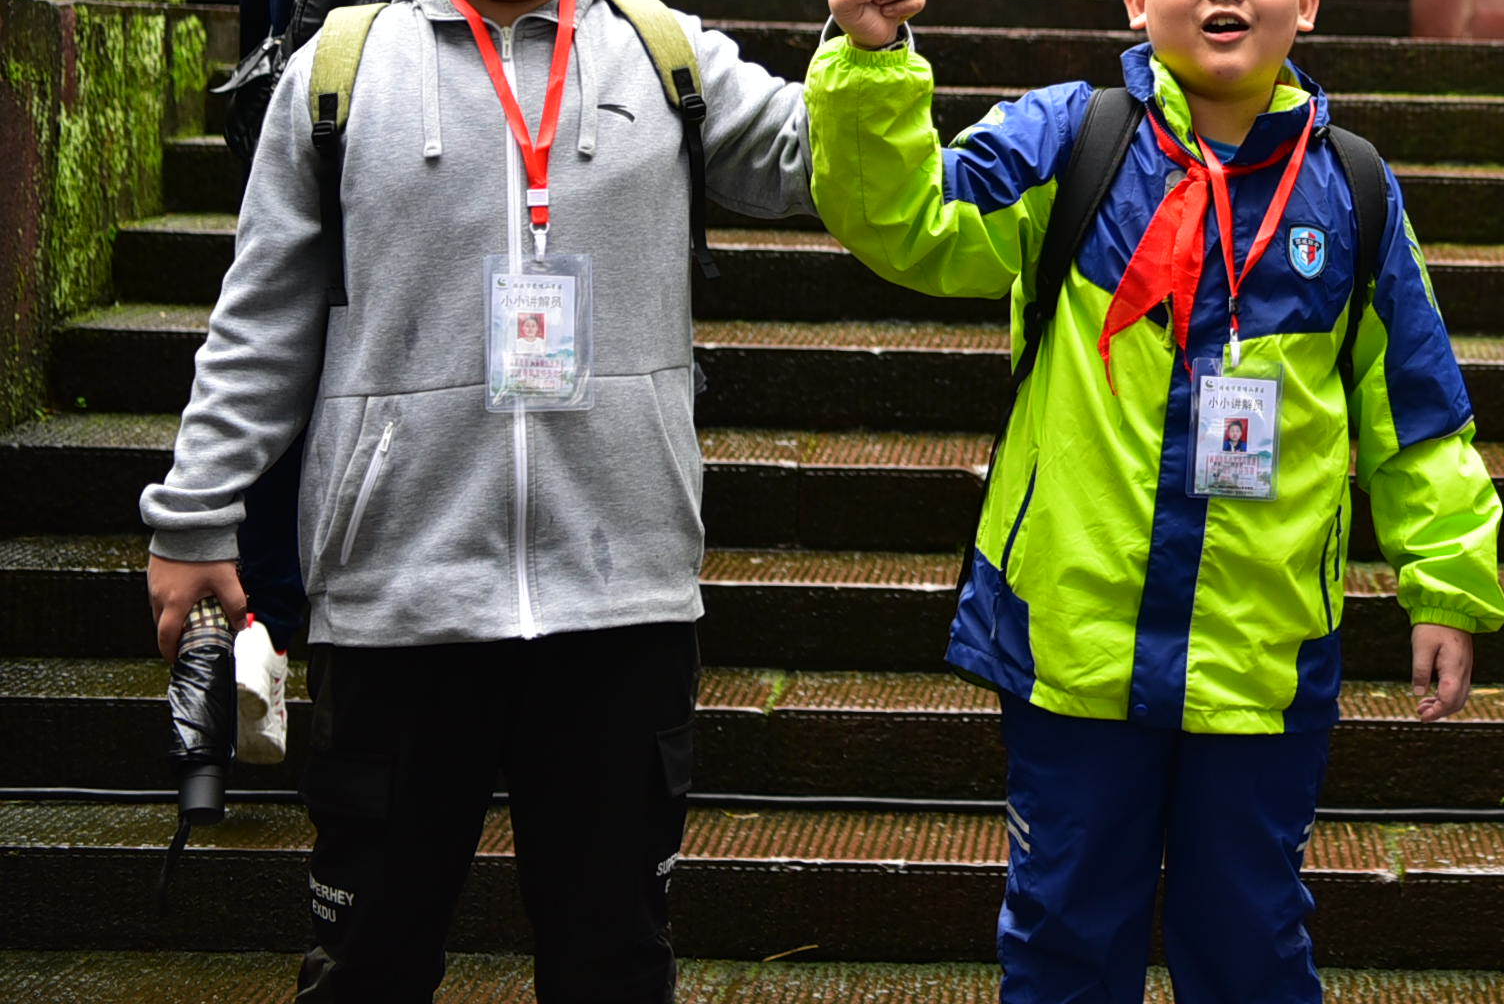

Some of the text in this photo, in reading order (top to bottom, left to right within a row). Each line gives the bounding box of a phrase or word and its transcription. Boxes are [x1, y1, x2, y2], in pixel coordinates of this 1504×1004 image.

[500, 294, 563, 309] 小小讲解员
